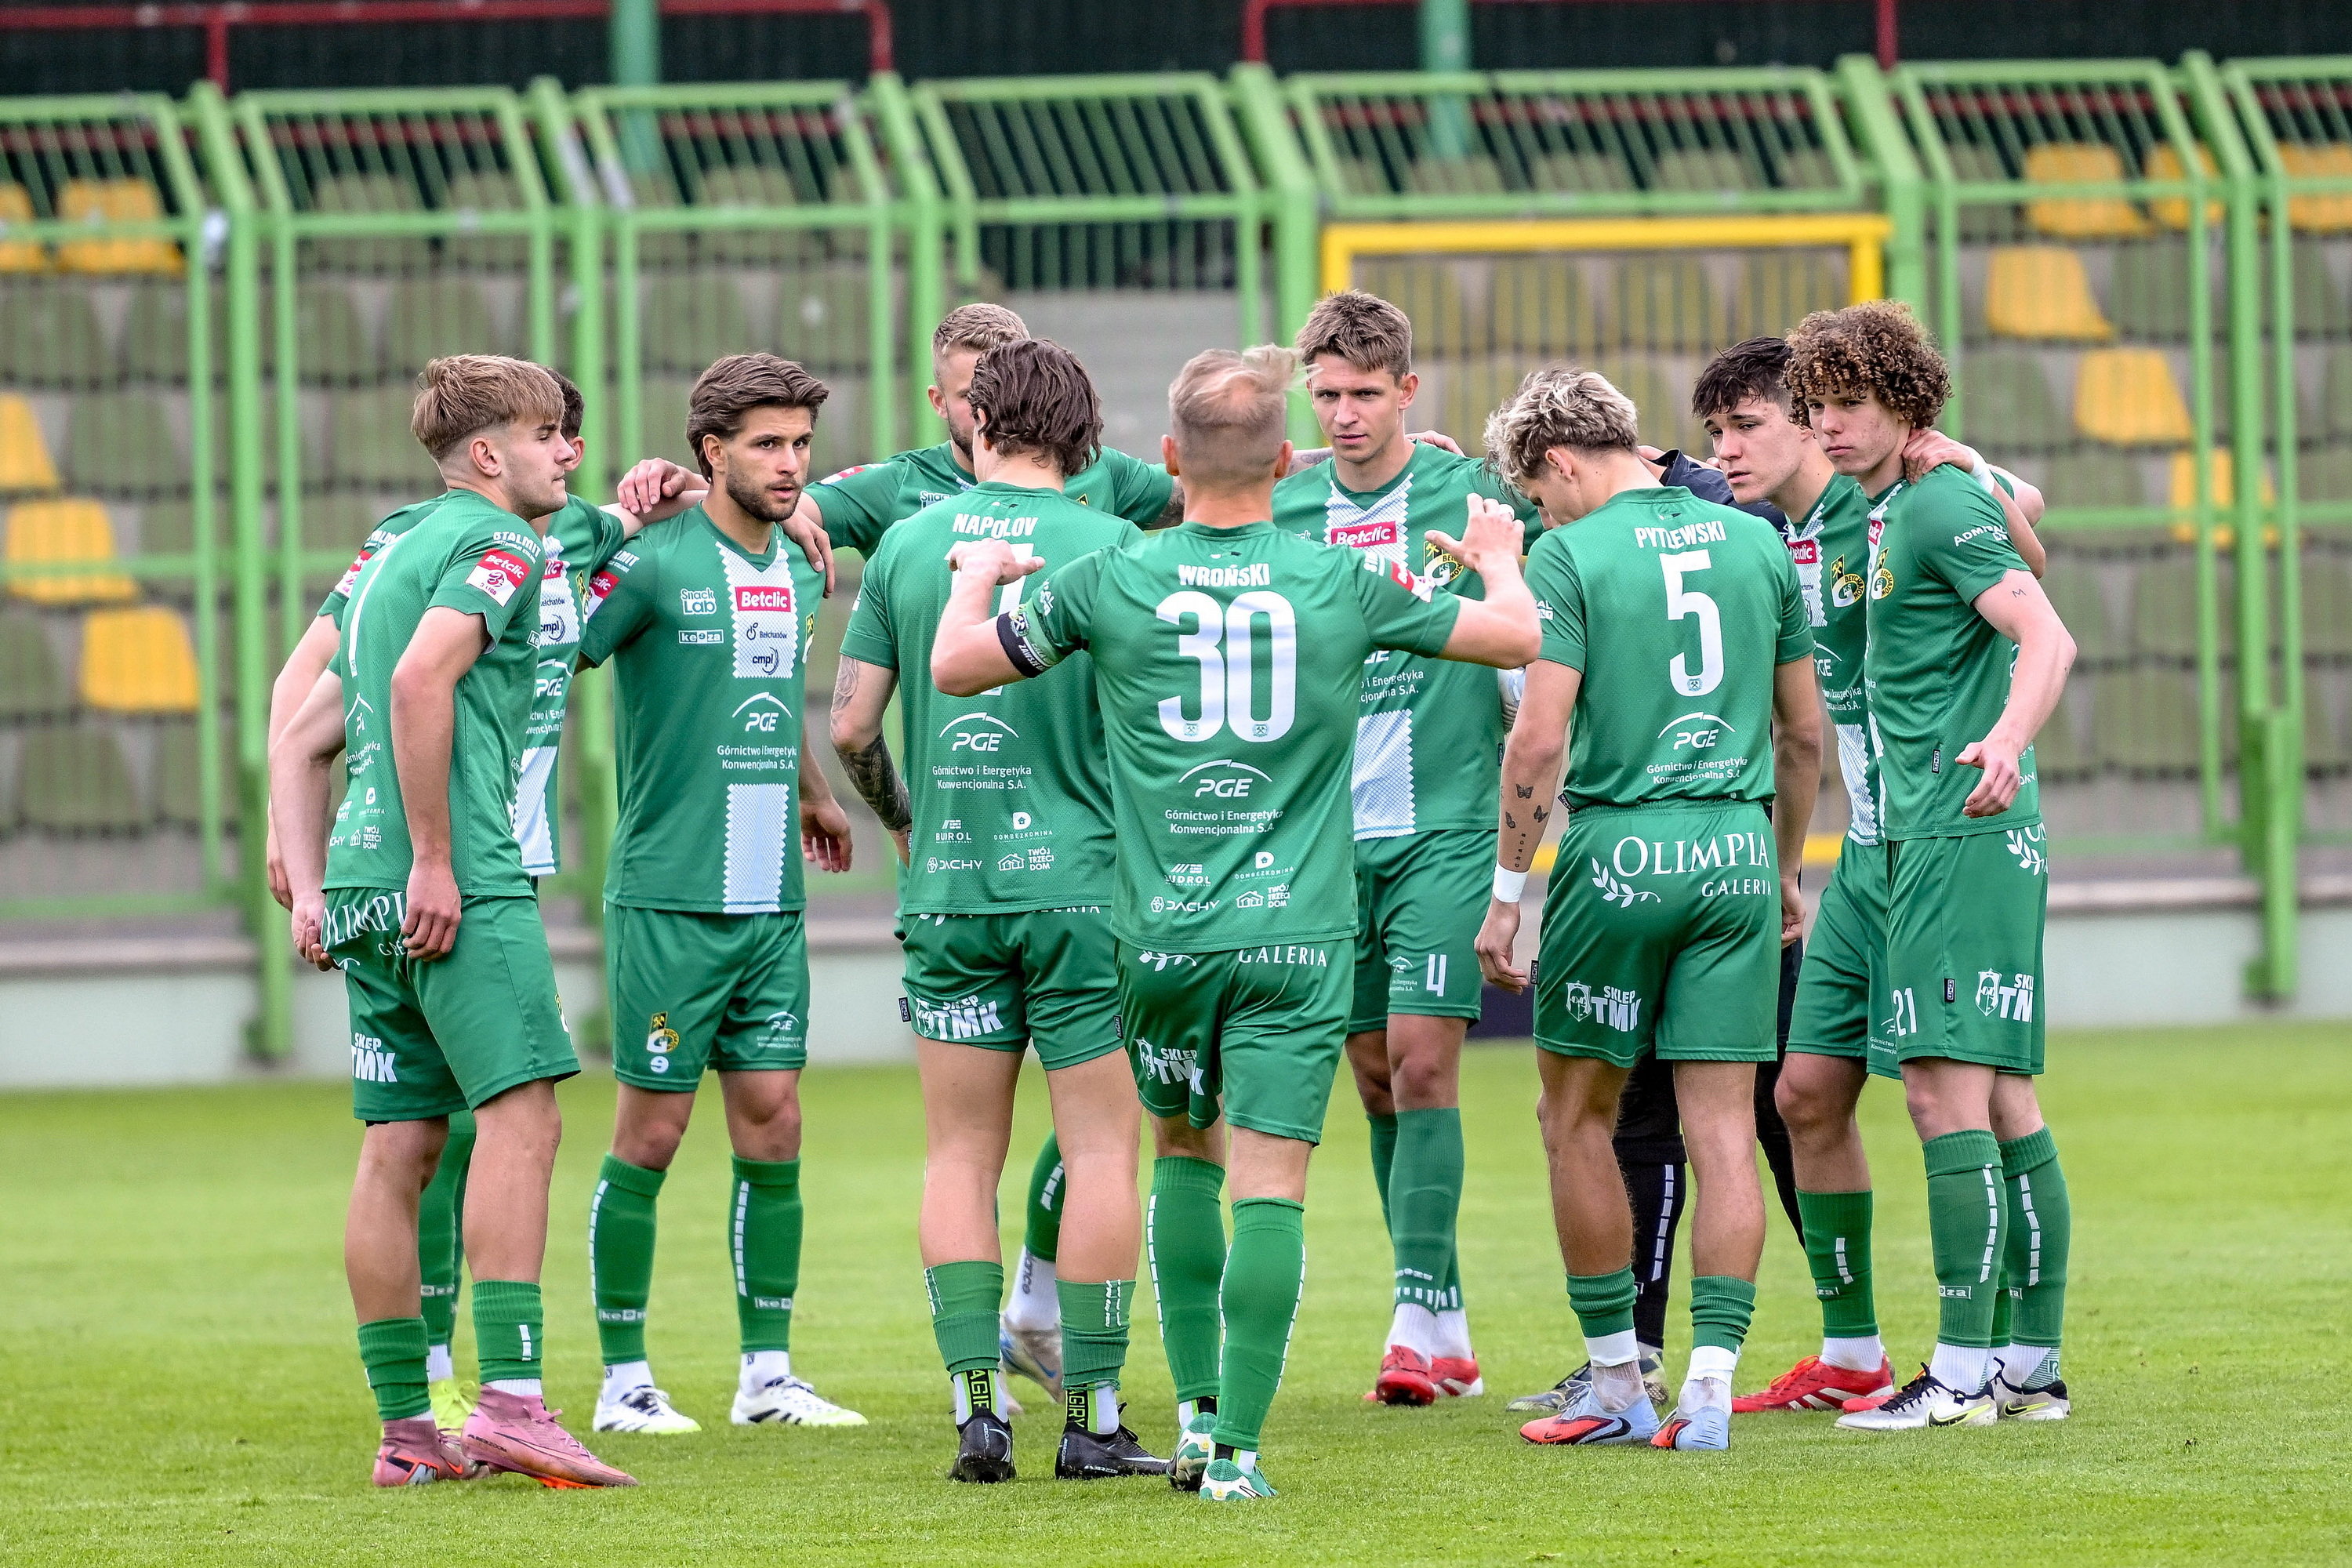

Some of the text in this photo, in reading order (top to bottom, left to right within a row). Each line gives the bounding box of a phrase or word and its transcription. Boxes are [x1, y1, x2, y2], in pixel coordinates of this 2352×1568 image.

[952, 513, 1039, 539] NAPOLOV
[1336, 526, 1392, 546] Betclic
[485, 555, 524, 579] Betclic
[614, 550, 640, 567] LMIT
[1178, 563, 1271, 586] WROŃSKI
[541, 597, 565, 606] ełchatów
[681, 587, 713, 600] Snack
[741, 591, 788, 608] Betclic
[684, 601, 717, 614] Lab
[1659, 550, 1724, 697] 5
[753, 654, 773, 667] cmpl
[1156, 590, 1297, 742] 30
[1373, 670, 1424, 688] Energetyka
[1399, 684, 1419, 695] S.A.
[745, 713, 779, 731] PGE
[952, 733, 1003, 751] PGE
[1673, 729, 1719, 750] PGE
[717, 745, 761, 756] Górnictwo
[779, 760, 796, 769] S.A.
[982, 765, 1032, 778] Energetyka
[1646, 762, 1692, 774] Górnictwo
[937, 779, 1026, 791] Konwencjonalna S.A.
[1195, 778, 1253, 797] PGE
[1165, 809, 1218, 821] Górnictwo
[1227, 809, 1283, 822] Energetyka
[363, 833, 382, 842] TRZECI
[1170, 823, 1254, 837] Konwencjonalna
[1028, 846, 1051, 855] TWÓJ
[1613, 832, 1770, 877] OLIMPIA
[1029, 855, 1054, 864] TRZECI
[1268, 883, 1290, 893] TWÓJ
[1701, 878, 1772, 897] GALERIA
[1268, 892, 1291, 901] TRZECI
[1166, 900, 1220, 912] DACHY
[1238, 946, 1327, 967] GALERIA
[1426, 953, 1447, 997] 4
[1603, 985, 1635, 1004] SKLEP
[932, 1000, 1004, 1040] TMK
[1592, 996, 1642, 1032] TMK
[1893, 987, 1917, 1036] 21
[1161, 1047, 1197, 1060] SKLEP
